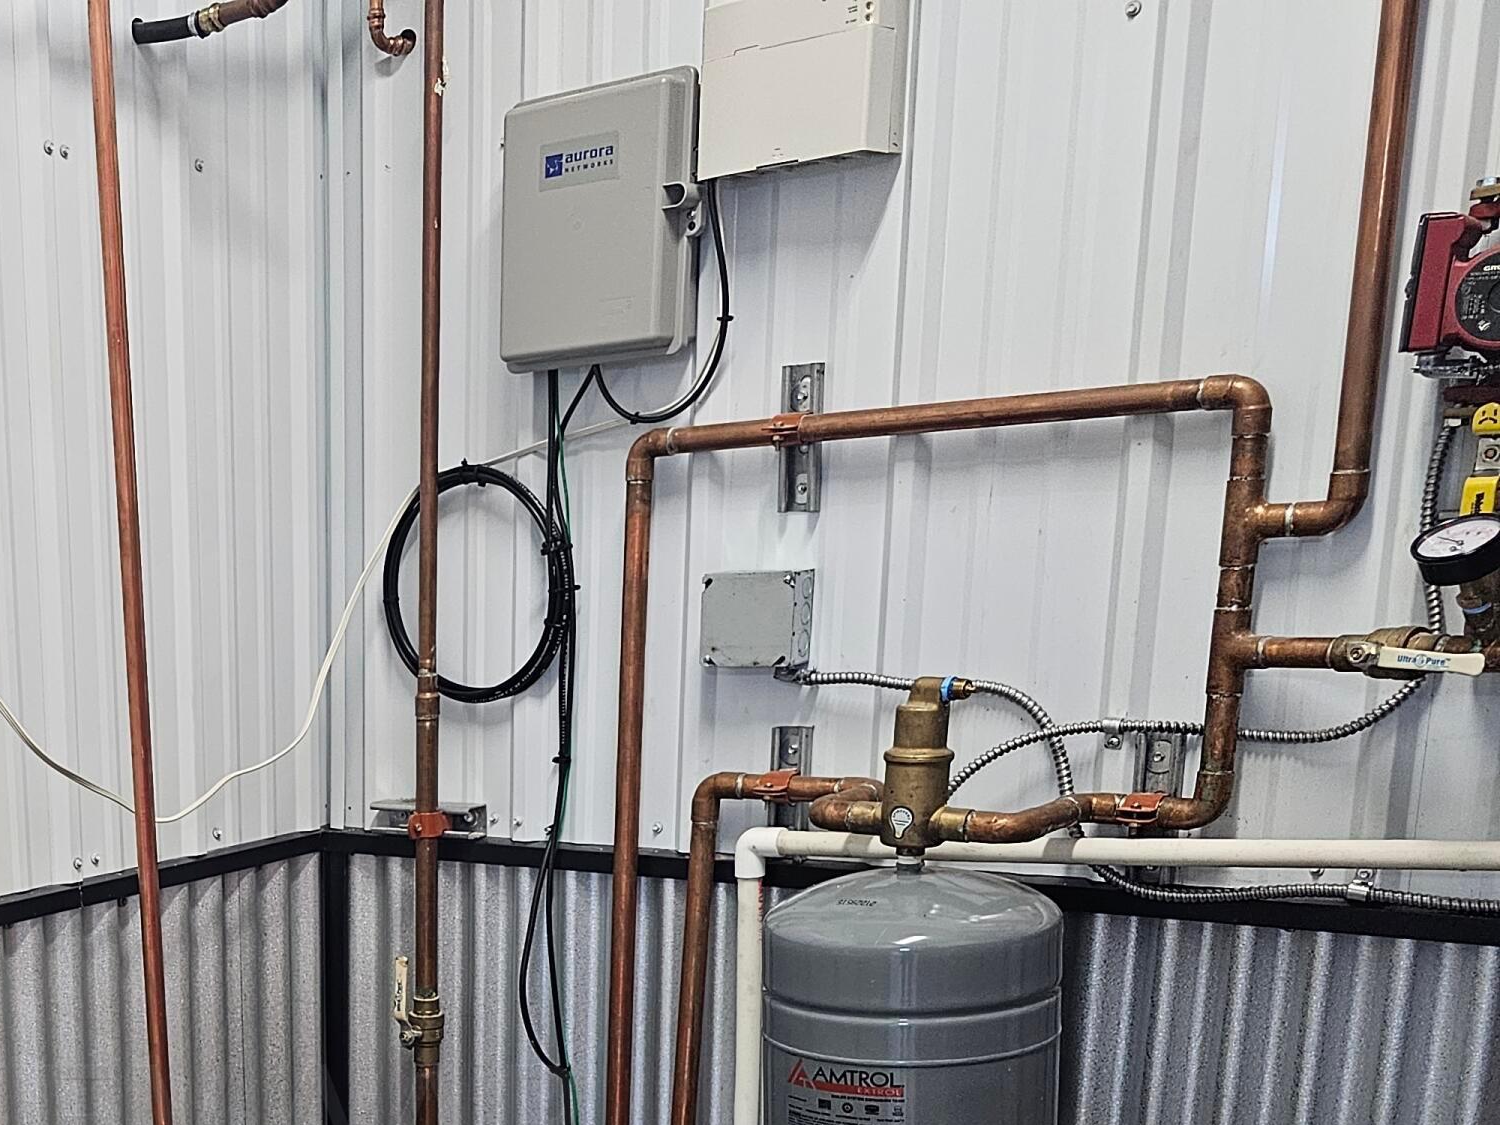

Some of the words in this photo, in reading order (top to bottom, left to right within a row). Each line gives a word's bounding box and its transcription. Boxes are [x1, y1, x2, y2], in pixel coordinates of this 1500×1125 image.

[565, 145, 614, 164] aurora
[565, 159, 614, 172] NETWORKS
[812, 1066, 903, 1088] AMTROL
[857, 1087, 902, 1097] EXTROL
